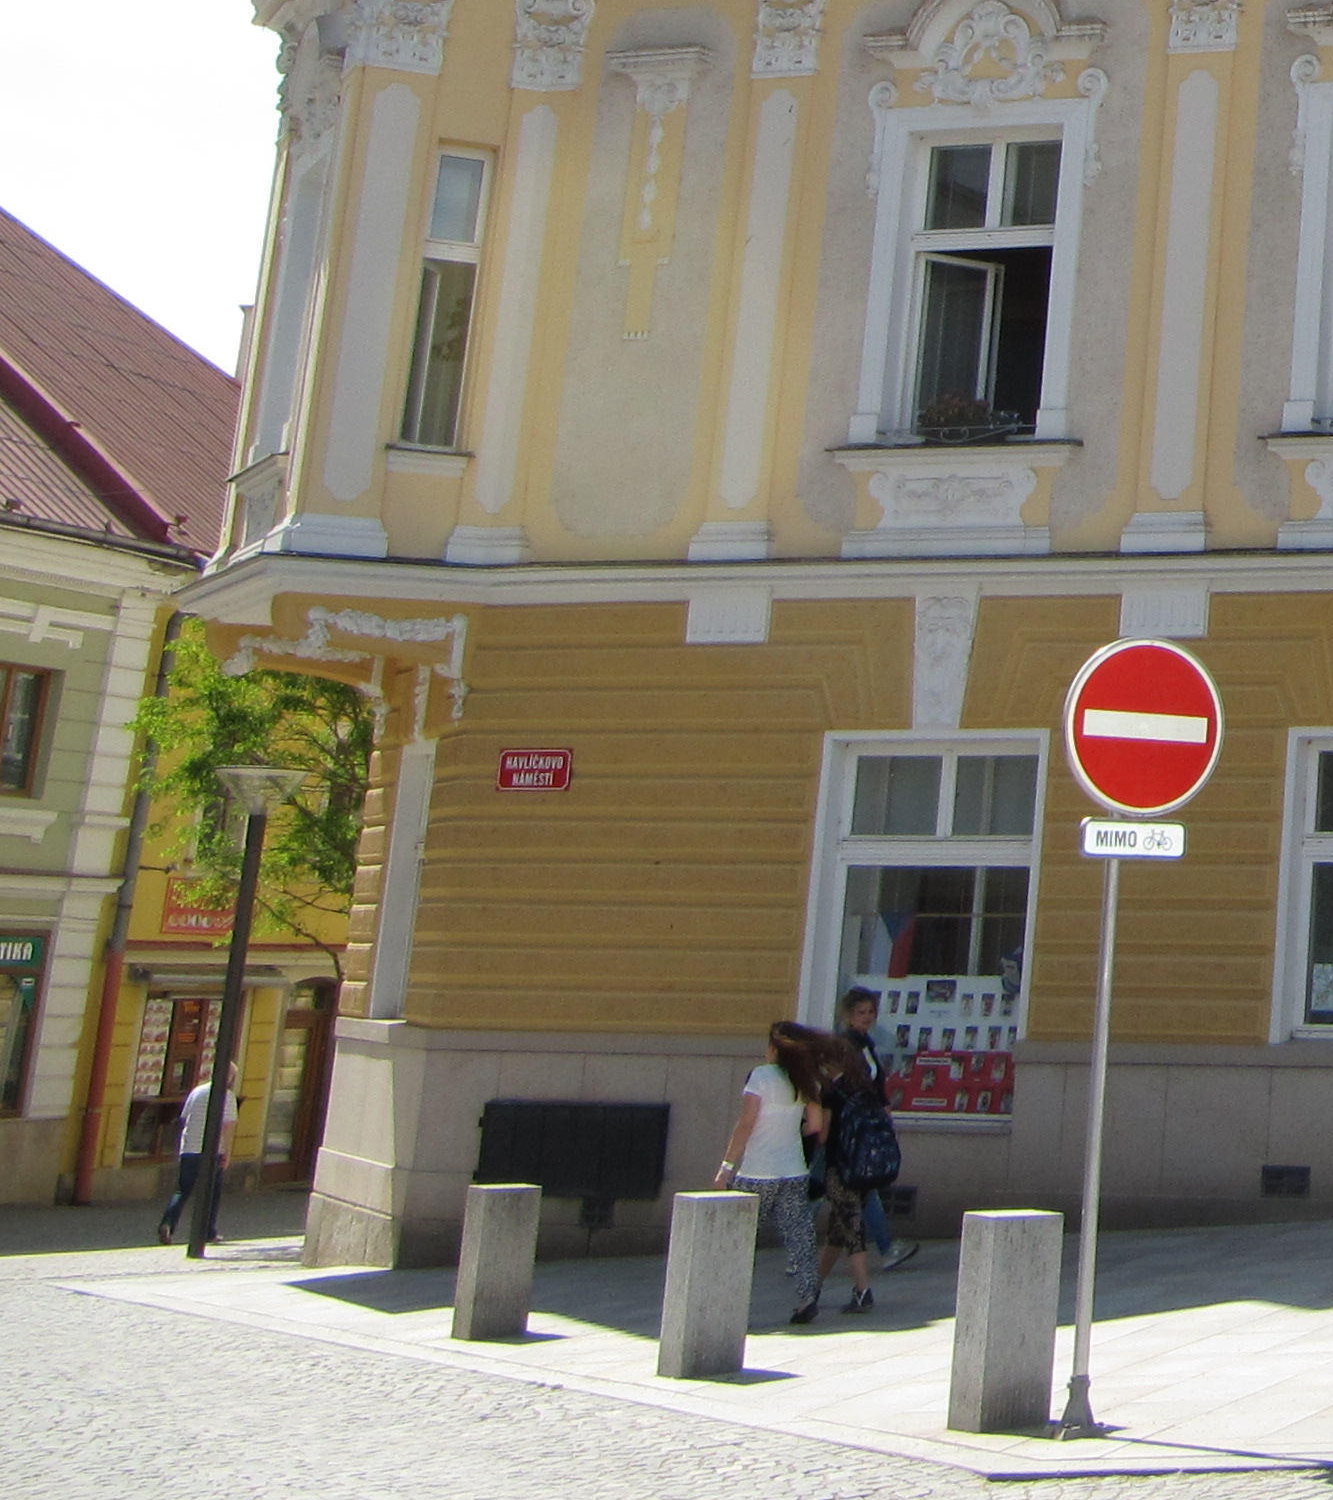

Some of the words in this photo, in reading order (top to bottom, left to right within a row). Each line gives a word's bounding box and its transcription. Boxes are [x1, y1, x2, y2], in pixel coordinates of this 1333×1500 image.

[505, 753, 564, 769] HAVLÍČKOVO
[512, 770, 554, 786] NÁMĚSTÍ
[1096, 829, 1138, 848] MIMO
